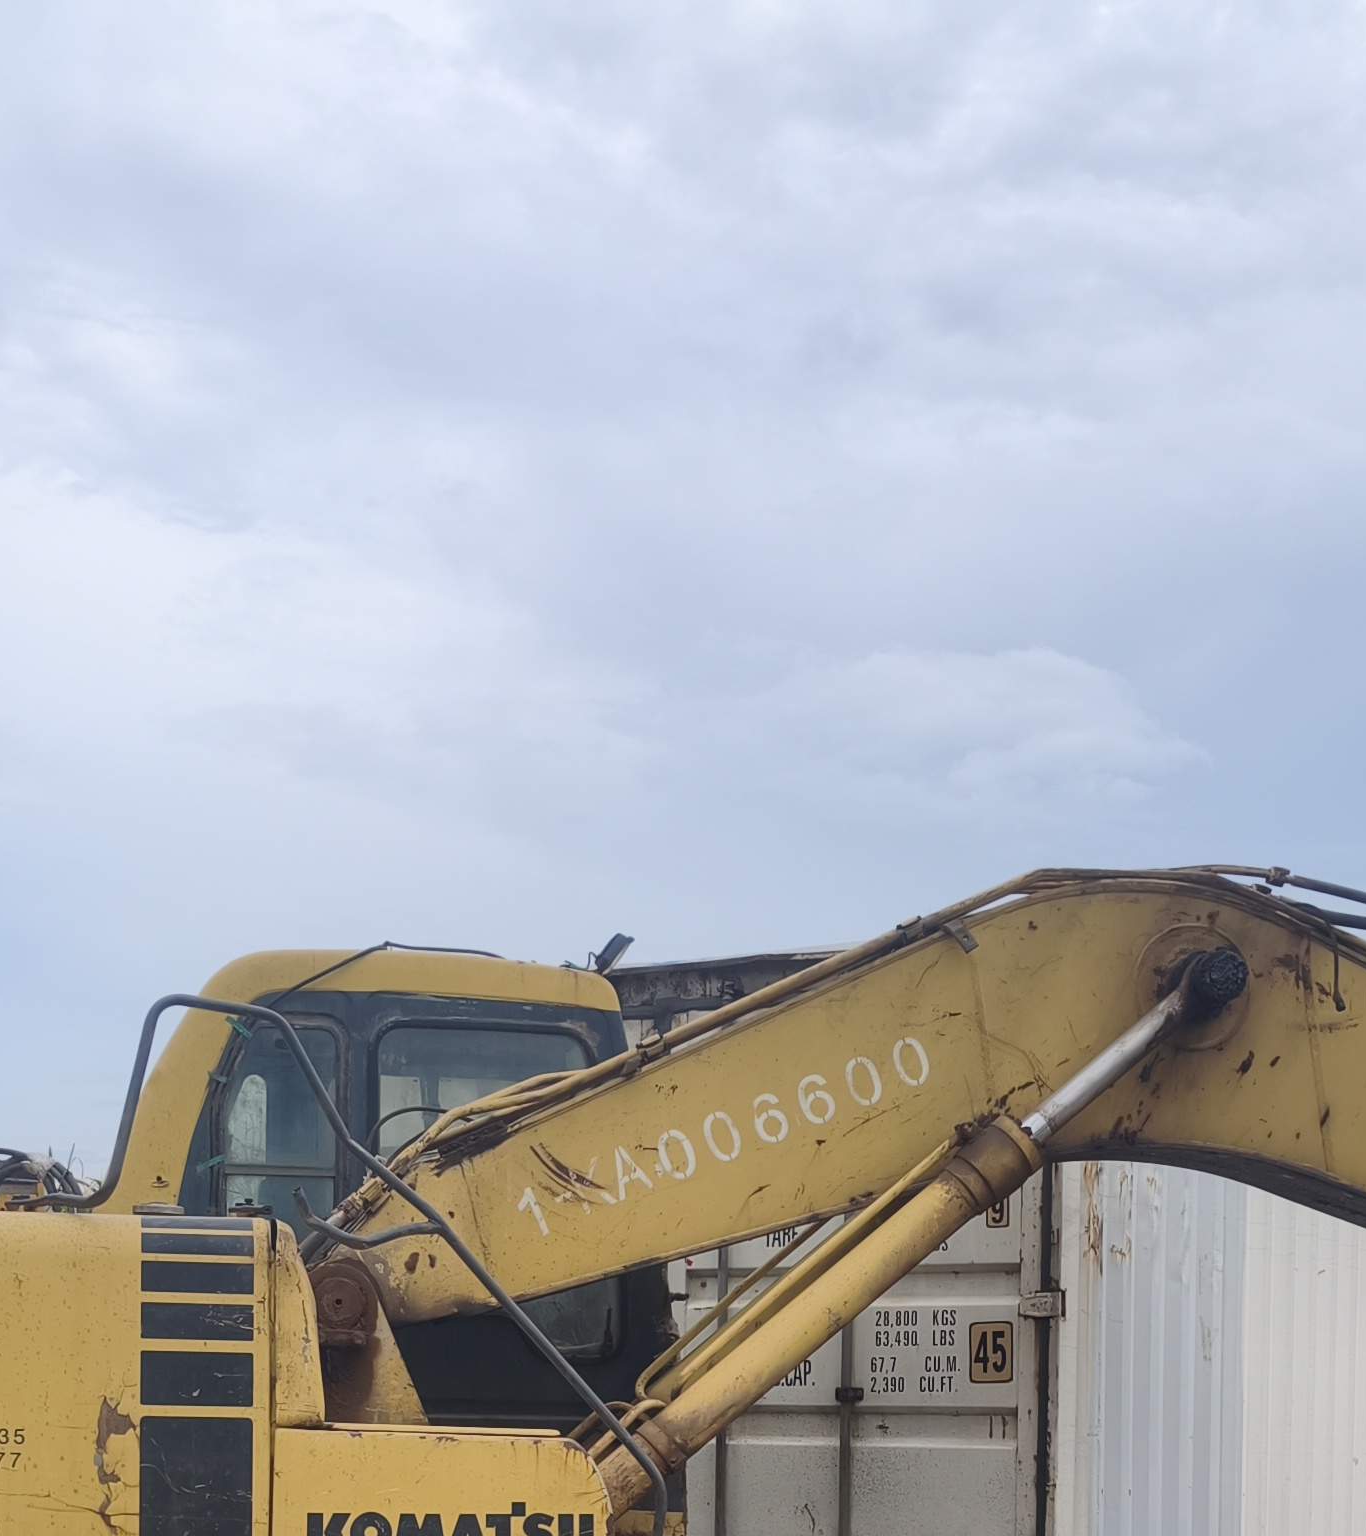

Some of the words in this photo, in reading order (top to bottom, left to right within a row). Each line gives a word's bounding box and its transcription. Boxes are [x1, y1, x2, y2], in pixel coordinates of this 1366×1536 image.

[875, 1310, 918, 1328] 28,800
[932, 1309, 957, 1326] KGS
[875, 1331, 918, 1348] 63,490
[932, 1330, 955, 1346] LBS
[973, 1330, 1007, 1374] 45
[870, 1377, 905, 1394] 2,390
